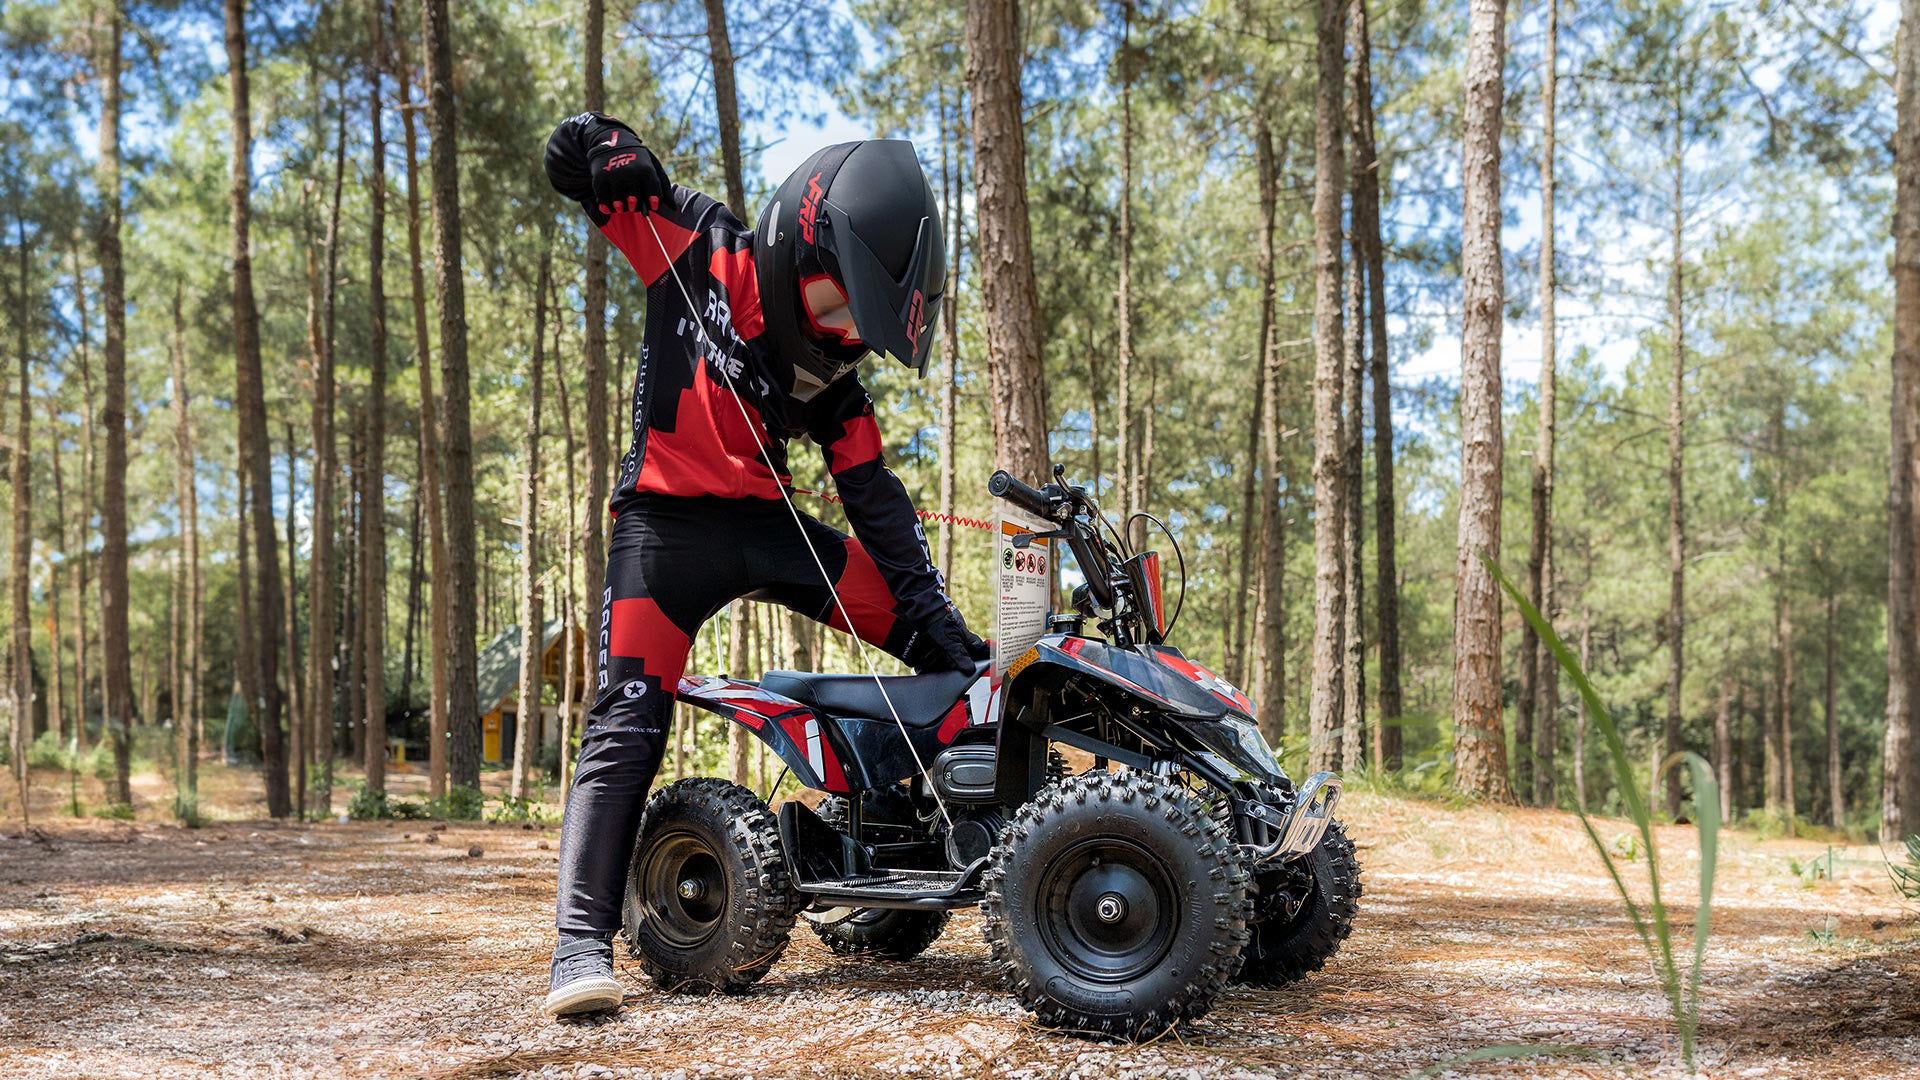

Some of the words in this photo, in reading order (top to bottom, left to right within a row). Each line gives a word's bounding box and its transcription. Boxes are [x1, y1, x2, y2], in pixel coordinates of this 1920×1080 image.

[603, 153, 637, 171] FRP
[798, 171, 823, 245] FRP
[598, 585, 612, 691] RACER
